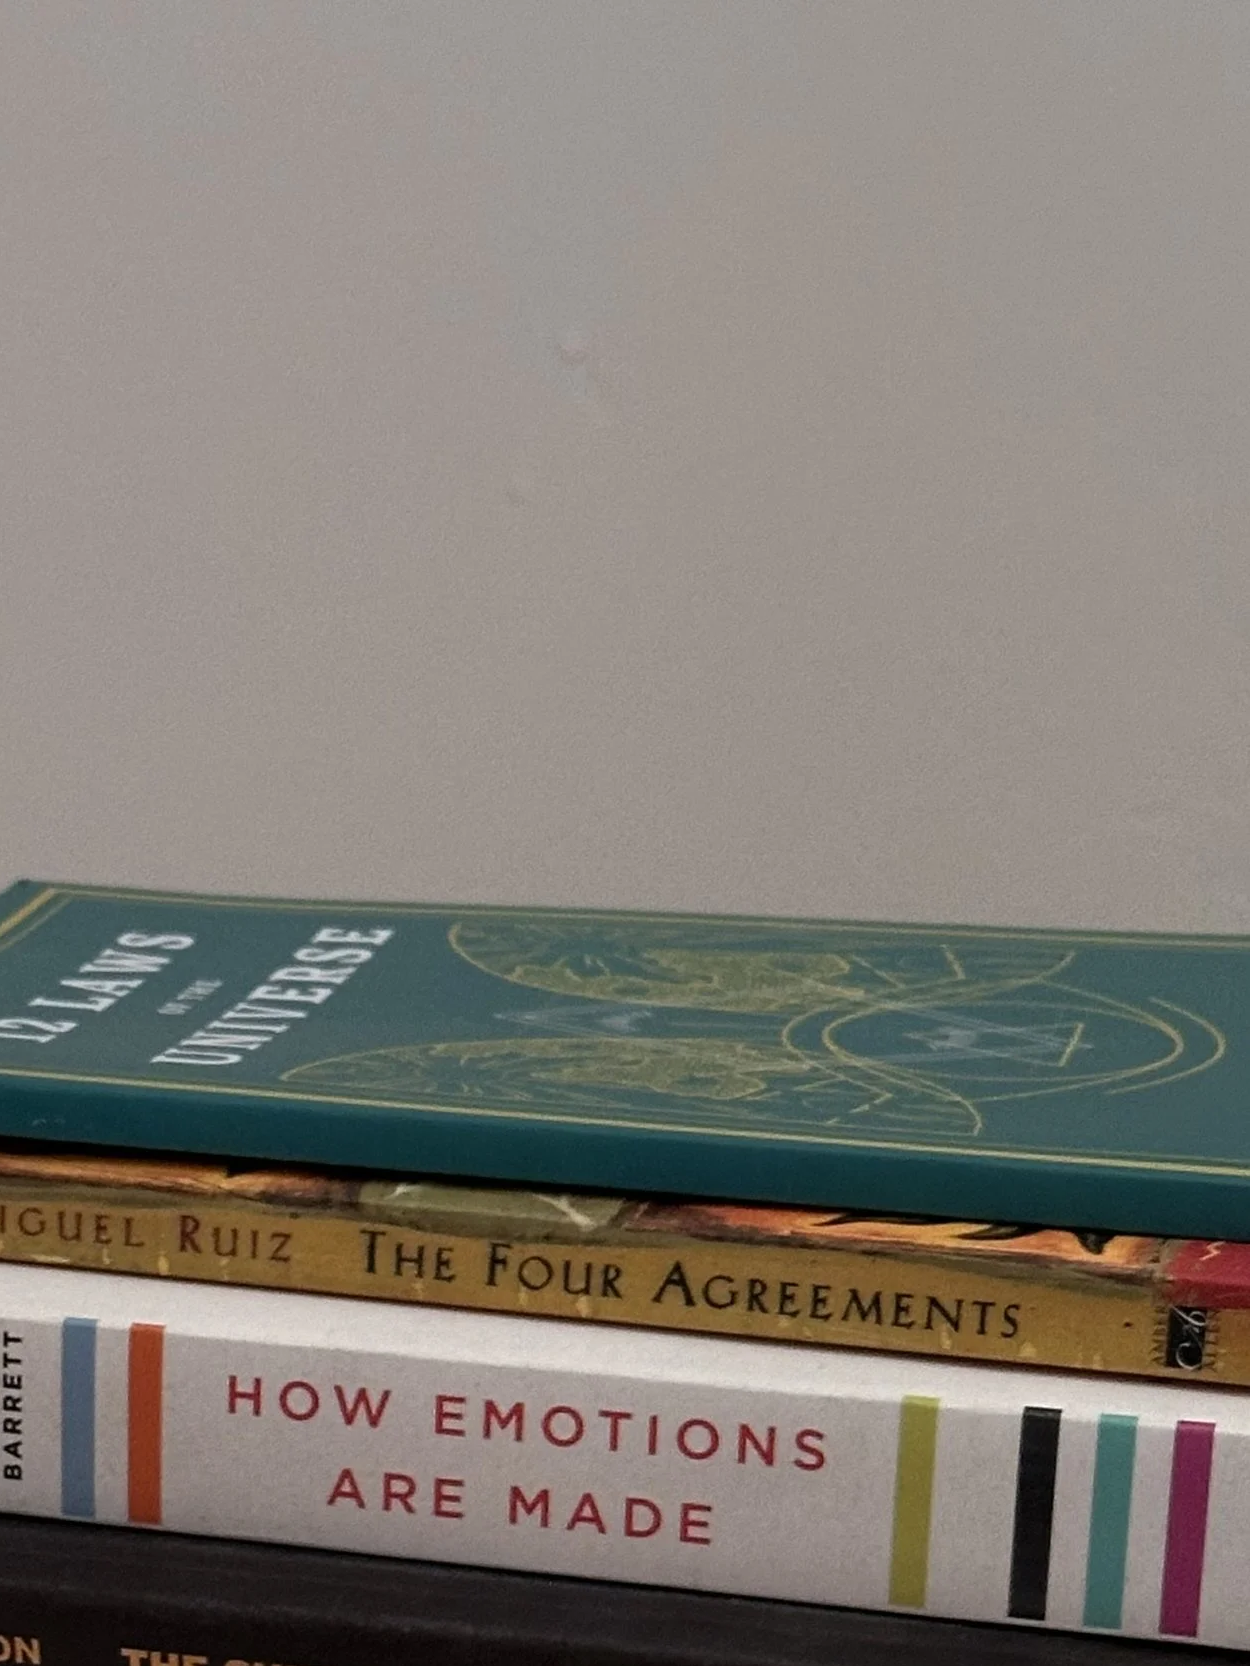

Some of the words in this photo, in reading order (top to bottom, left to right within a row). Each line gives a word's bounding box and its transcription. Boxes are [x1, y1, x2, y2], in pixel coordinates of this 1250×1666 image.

[27, 932, 196, 1012] LAWS
[151, 927, 395, 1067] UNIVERSE
[180, 1214, 294, 1263] RUIZ
[359, 1228, 456, 1282] THE
[487, 1242, 622, 1298] FOUR
[652, 1260, 1022, 1338] AGREEMENTS
[2, 1330, 24, 1481] BARRETT
[227, 1374, 393, 1430] HOW
[435, 1394, 826, 1472] EMOTIONS
[327, 1468, 464, 1517] ARE
[507, 1486, 712, 1546] MADE
